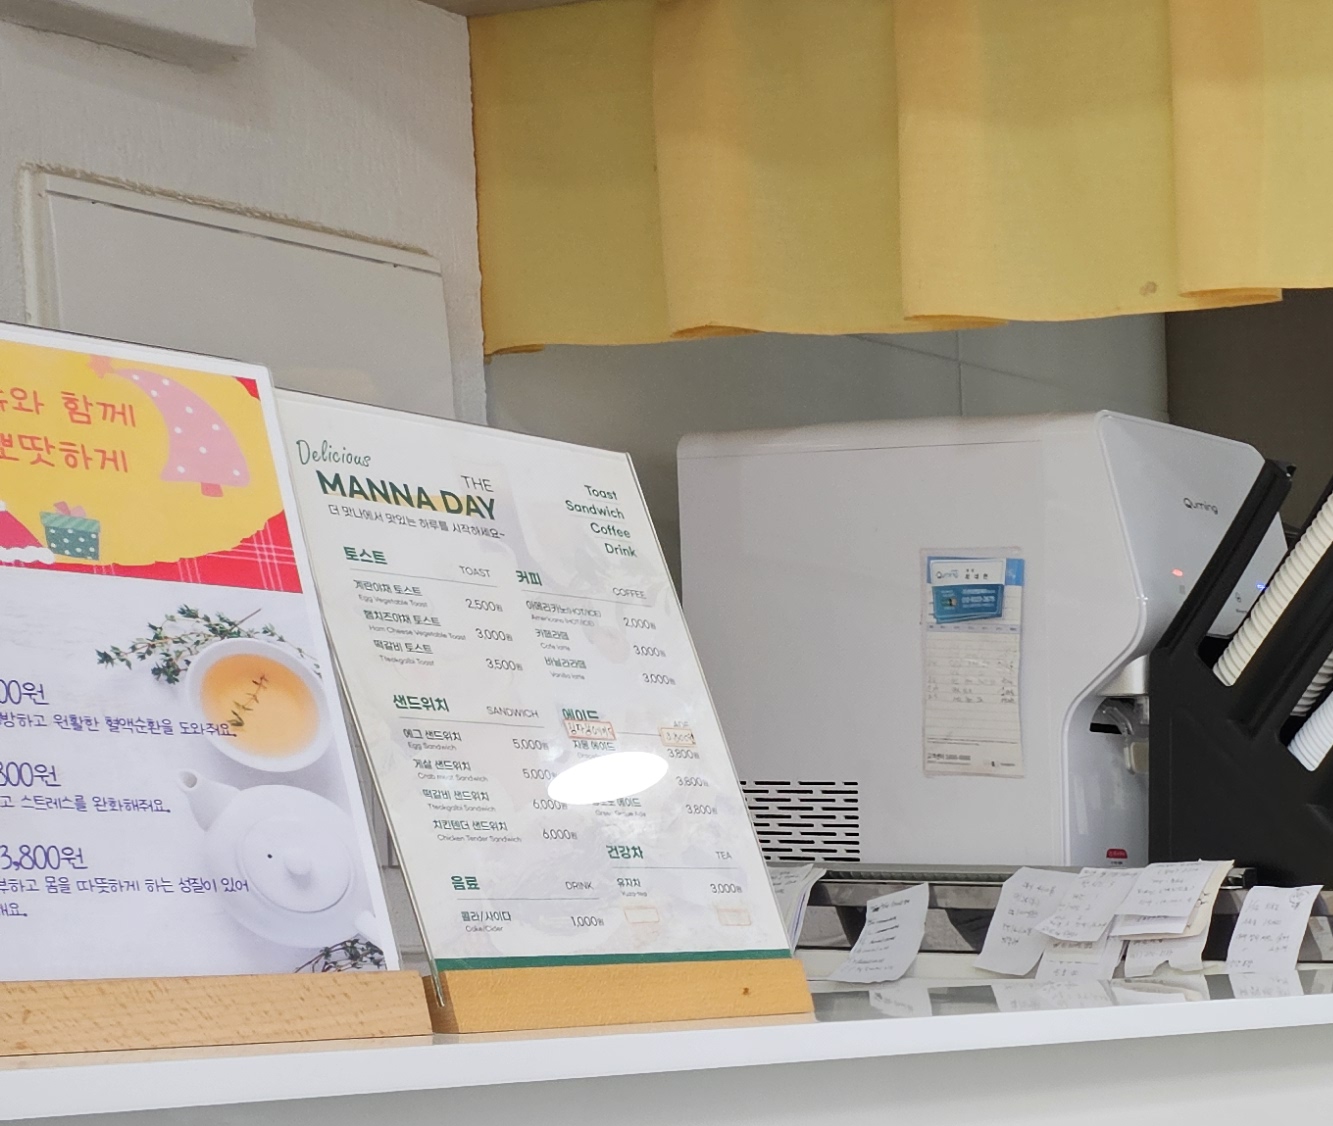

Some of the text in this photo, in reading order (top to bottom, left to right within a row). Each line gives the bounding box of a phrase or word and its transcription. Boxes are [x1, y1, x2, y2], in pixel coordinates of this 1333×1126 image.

[0, 387, 136, 427] 와 함께
[296, 440, 371, 467] Delicious
[461, 475, 494, 492] THE
[316, 470, 495, 520] MANNA DAY
[584, 485, 618, 500] Toast
[328, 504, 340, 515] 더
[342, 506, 384, 522] 맛나에서
[386, 513, 417, 528] 맛있는
[419, 518, 449, 532] 하루를
[565, 500, 625, 520] Sandwich
[590, 522, 630, 538] Coffee
[604, 543, 637, 558] Drink
[344, 546, 490, 578] 토스트 TOAST
[353, 580, 392, 594] 계란야채
[393, 585, 423, 596] 토스트
[516, 571, 646, 599] 커피 COFFEE
[413, 615, 441, 626] 토스트
[404, 642, 433, 654] 토스트
[393, 695, 539, 718] 샌드위치 SANDWICH
[562, 708, 599, 720] 에이드
[54, 714, 100, 732] 원활한
[105, 716, 174, 736] 혈액순환을
[403, 729, 423, 740] 에그
[425, 730, 462, 742] 샌드위치
[413, 759, 433, 769] 게살
[435, 760, 471, 771] 샌드위치
[454, 790, 490, 801] 샌드위치
[21, 795, 87, 812] 스트레스를
[92, 797, 171, 813] 완화해줘요.
[433, 819, 470, 831] 치킨텐더
[472, 820, 508, 831] 샌드위치
[0, 845, 88, 870] 3,800원
[606, 845, 732, 860] 건강차 TEA
[45, 876, 71, 894] 몸을
[77, 878, 139, 893] 따뜻하게
[145, 878, 173, 893] 하는
[178, 877, 217, 893] 성질이
[221, 878, 249, 892] 있어
[451, 875, 593, 891] 음료 DRINK
[617, 878, 641, 887] 유자차
